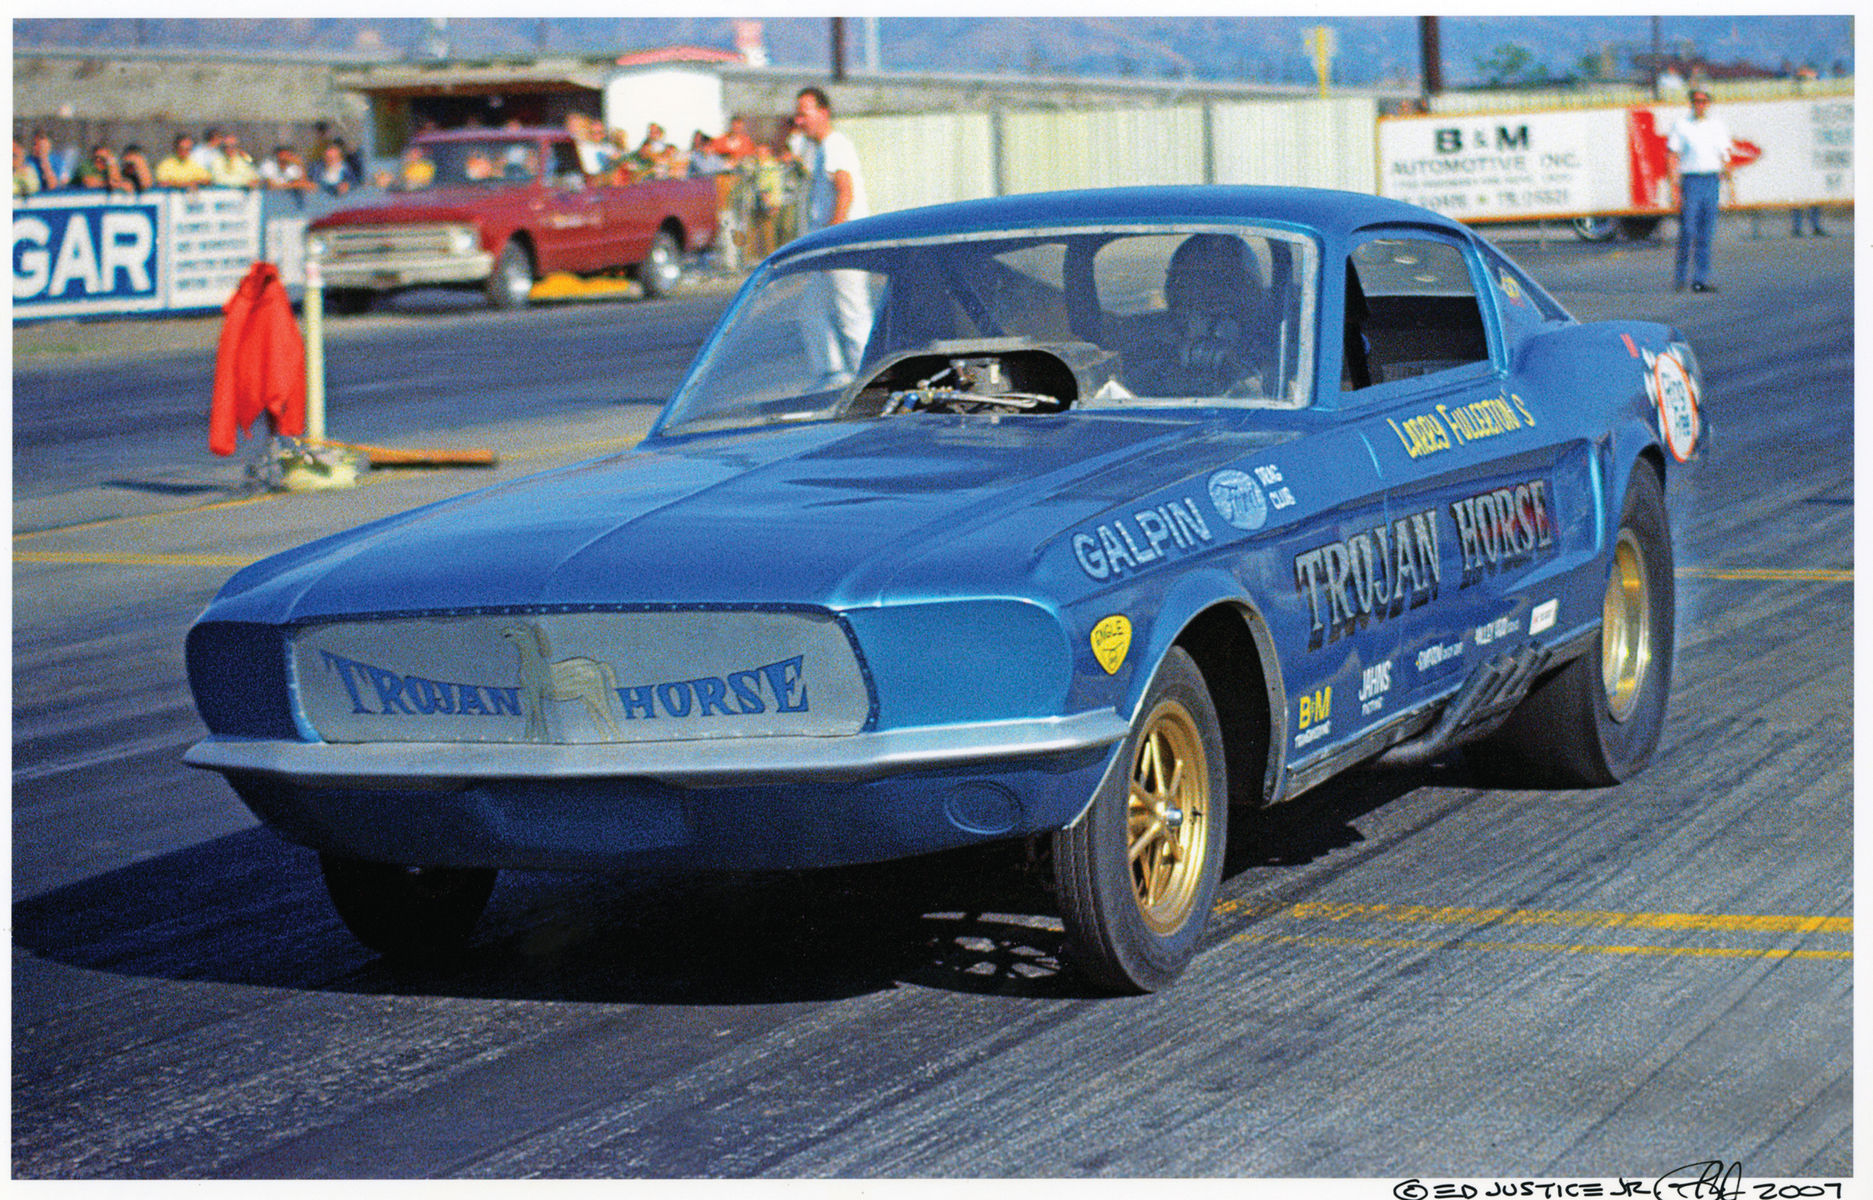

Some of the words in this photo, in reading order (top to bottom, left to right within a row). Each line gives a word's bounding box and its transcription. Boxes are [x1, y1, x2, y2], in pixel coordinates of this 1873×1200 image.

[1393, 156, 1526, 175] AUTOMOTIVE
[1435, 127, 1463, 153] B
[1496, 125, 1529, 150] M
[12, 211, 153, 300] GAR
[1072, 497, 1213, 580] GALPIN
[1295, 509, 1440, 634] TROJAN
[1451, 479, 1553, 572] HORSE
[320, 650, 523, 716] TROJAN
[614, 655, 809, 720] HORSE
[1433, 1184, 1478, 1199] ED
[1485, 1181, 1604, 1199] JUSTICE
[1610, 1177, 1652, 1197] JR
[1753, 1183, 1842, 1199] 2007
